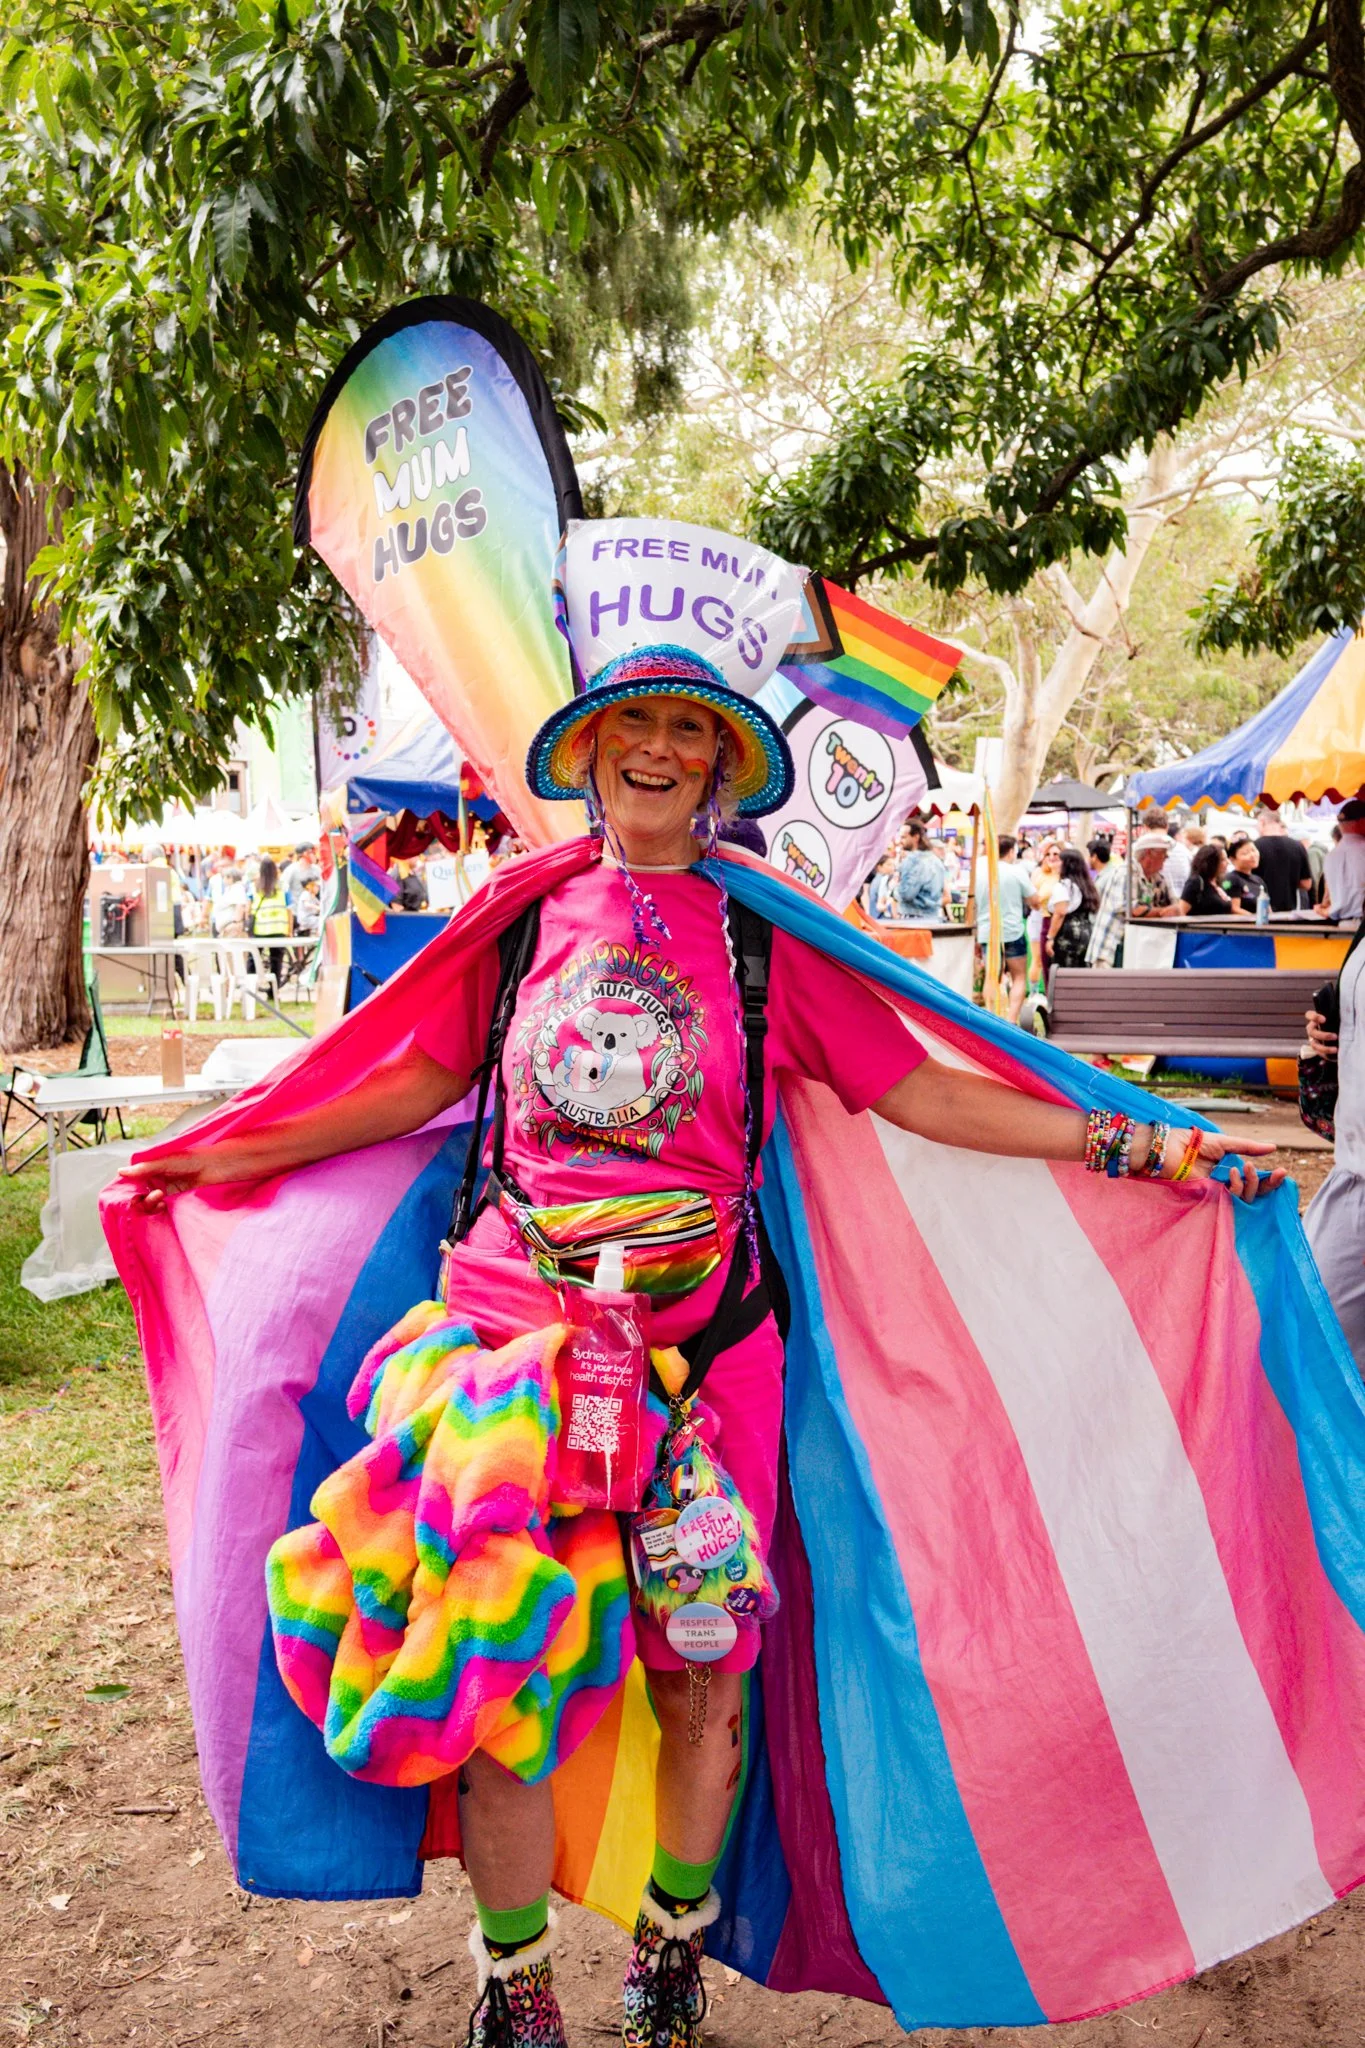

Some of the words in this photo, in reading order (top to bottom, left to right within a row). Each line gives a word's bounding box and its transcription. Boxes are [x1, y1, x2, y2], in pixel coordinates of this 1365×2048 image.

[365, 365, 473, 464] FREE
[373, 426, 470, 518] MUM
[374, 488, 487, 582] HUGS
[592, 538, 690, 562] FREE
[590, 584, 768, 669] HUGS
[826, 731, 884, 801] Twenty
[825, 762, 860, 808] 10
[432, 863, 483, 880] Quers
[782, 832, 825, 888] Twenty
[556, 992, 589, 1022] FREE
[591, 983, 635, 999] MUM
[636, 992, 673, 1035] HUGS
[558, 1100, 641, 1125] AUSTRALIA
[571, 1347, 609, 1364] Sydney,
[570, 1371, 598, 1383] health
[598, 1373, 633, 1387] district
[591, 1363, 614, 1373] your
[613, 1364, 634, 1375] local
[680, 1511, 714, 1537] FREE
[701, 1513, 735, 1541] MUM
[680, 1618, 719, 1627] RESPECT
[685, 1629, 716, 1637] TRANS
[684, 1640, 719, 1649] PEOPLE
